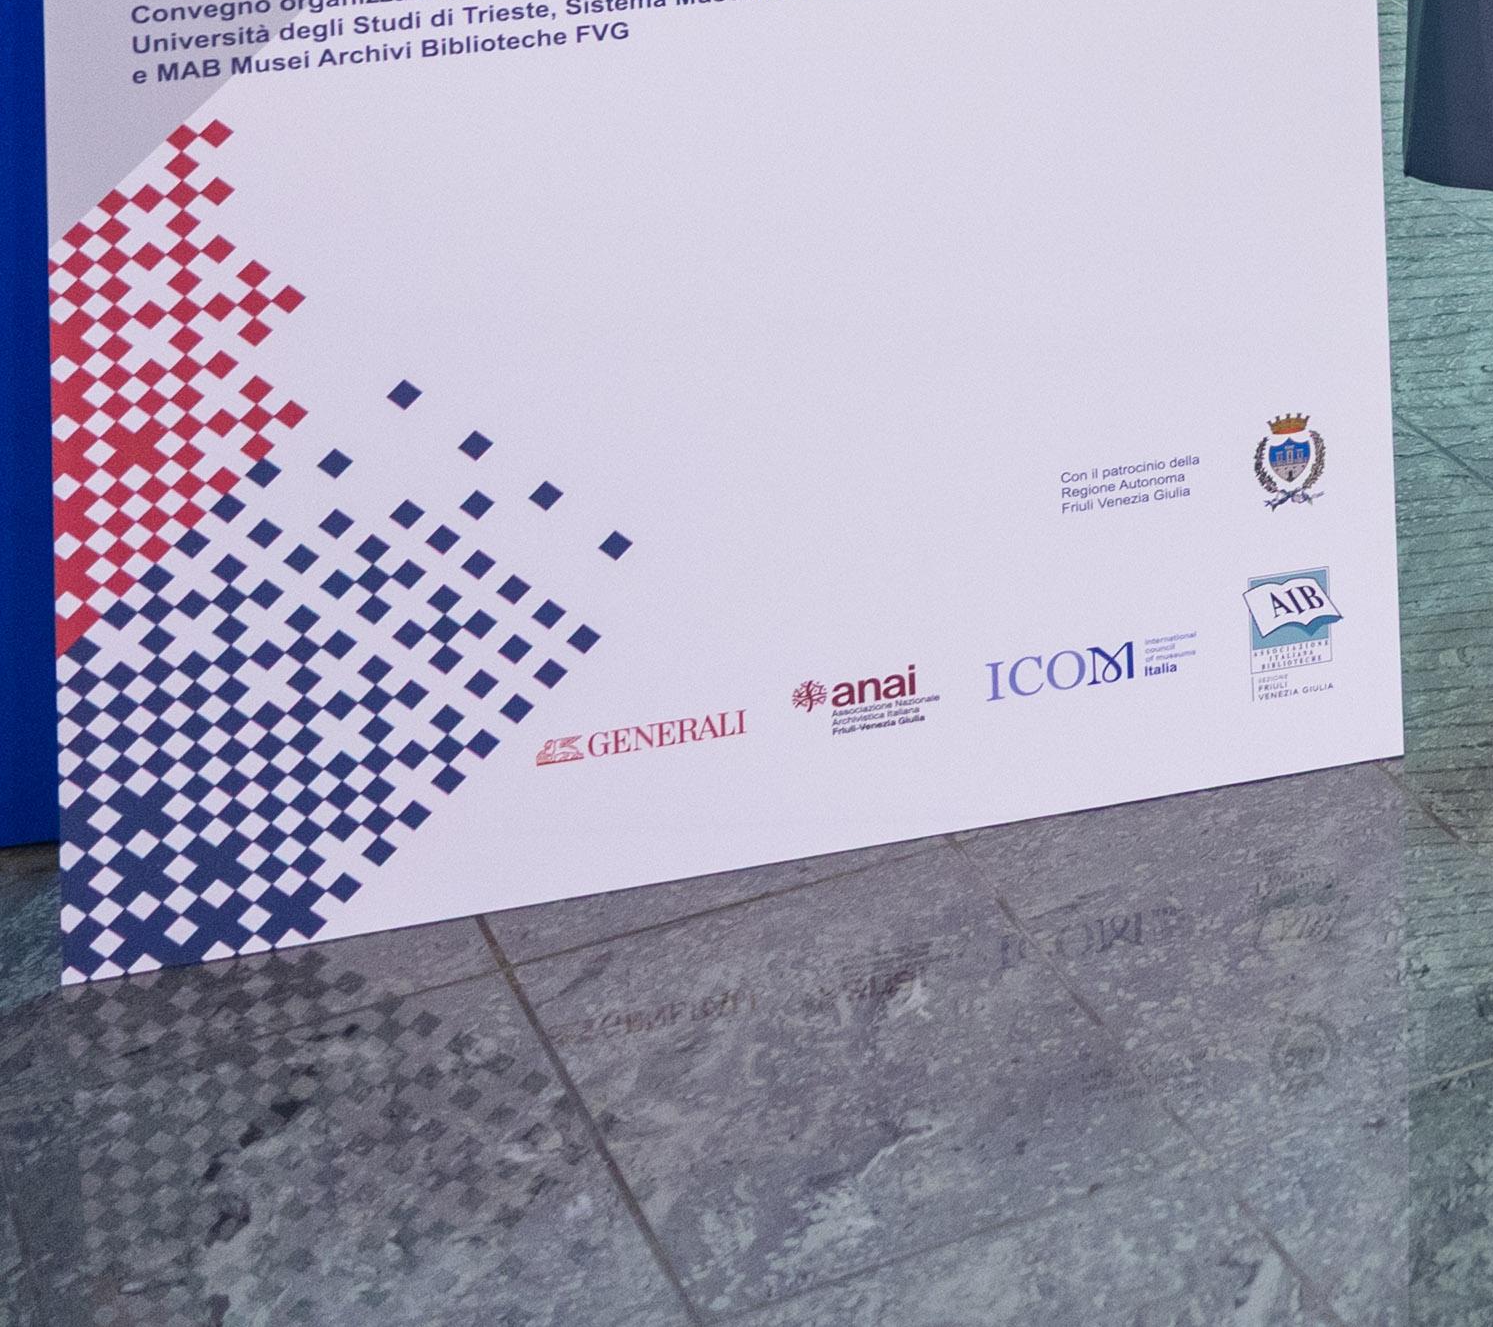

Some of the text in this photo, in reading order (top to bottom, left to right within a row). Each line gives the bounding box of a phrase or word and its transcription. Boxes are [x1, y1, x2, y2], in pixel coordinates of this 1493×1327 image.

[132, 24, 270, 55] Università
[280, 19, 344, 44] degli
[354, 13, 422, 35] Studi
[431, 8, 453, 28] di
[463, 2, 557, 27] Trieste,
[132, 21, 630, 85] e MAB Musei Archivi Biblioteche FVG
[1060, 455, 1200, 483] Con il patrocinio della
[1061, 473, 1185, 499] Regione Autonoma
[1061, 487, 1191, 514] Friuli Venezia Giulia
[1271, 584, 1325, 619] AIB
[831, 664, 916, 707] anai
[986, 641, 1135, 702] ICOM
[1144, 662, 1177, 676] Italia
[1258, 682, 1334, 701] VENEZIA GIULIA
[587, 709, 747, 757] GENERALI
